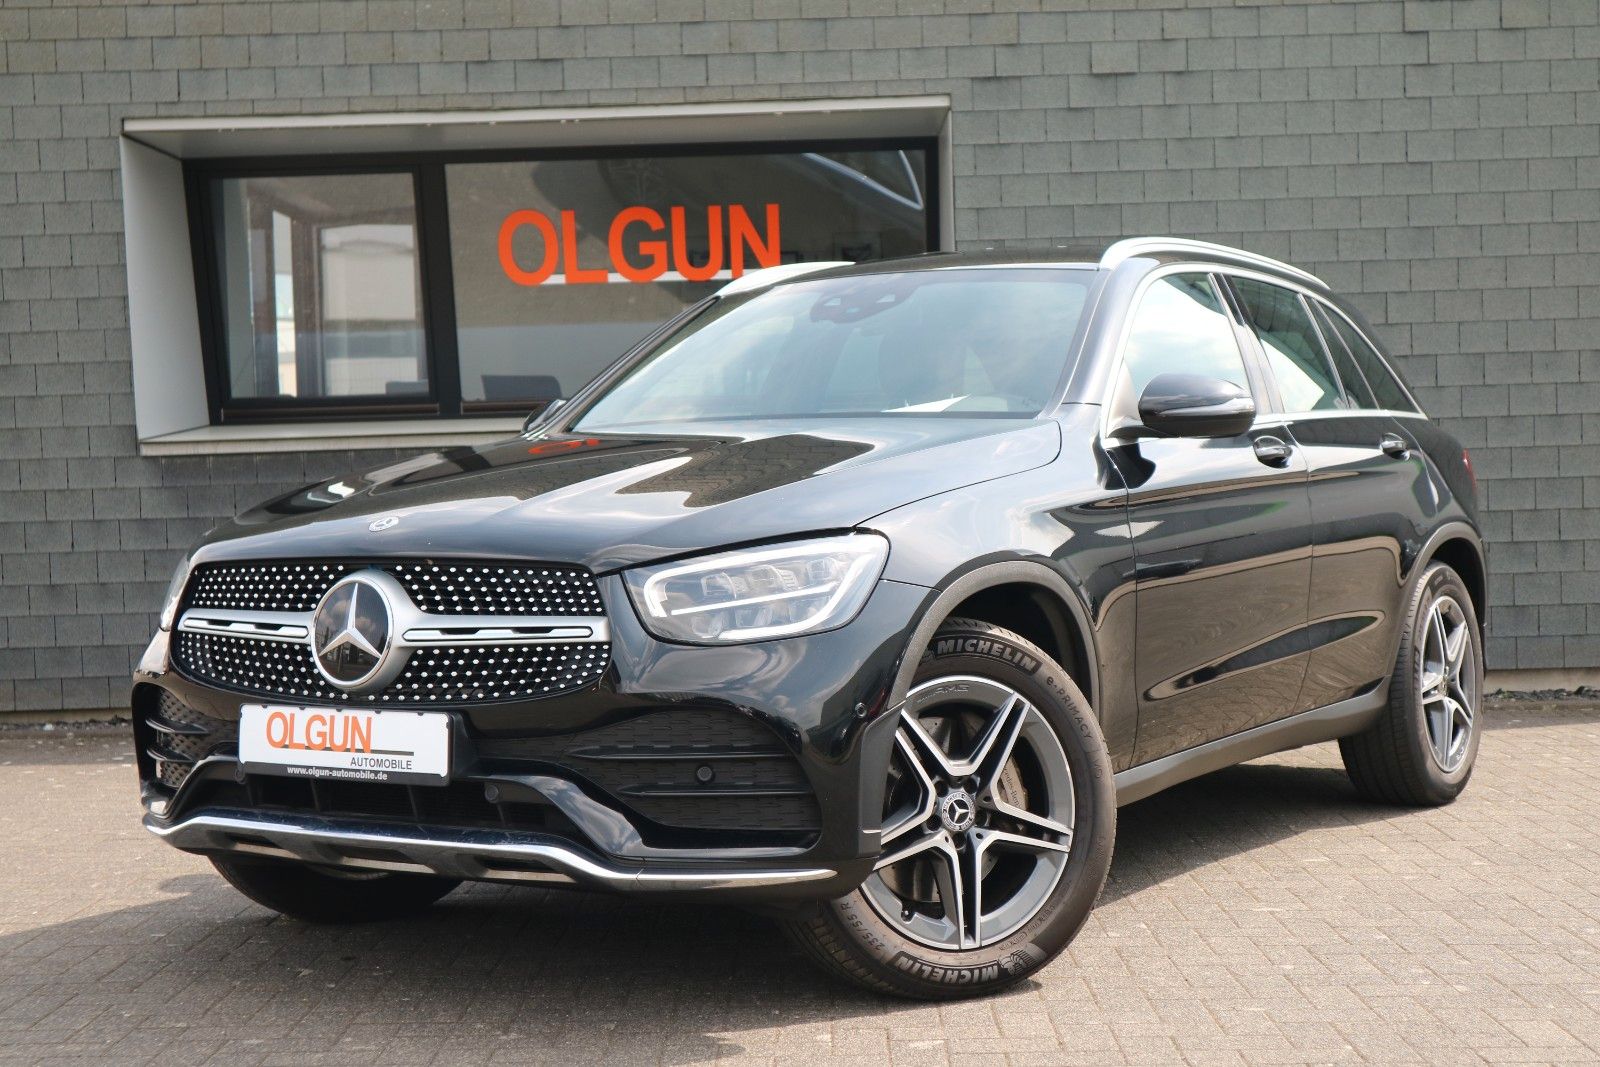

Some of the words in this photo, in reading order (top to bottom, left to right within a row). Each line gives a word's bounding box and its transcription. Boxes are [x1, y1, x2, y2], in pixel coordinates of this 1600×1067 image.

[498, 203, 781, 287] OLGUN
[937, 639, 1037, 671] MICHELIN
[266, 711, 372, 754] OLGUN
[287, 767, 388, 781] www.olgun-automobile.de
[350, 757, 412, 770] AUTOMOBILE
[894, 956, 999, 984] MICHELIN
